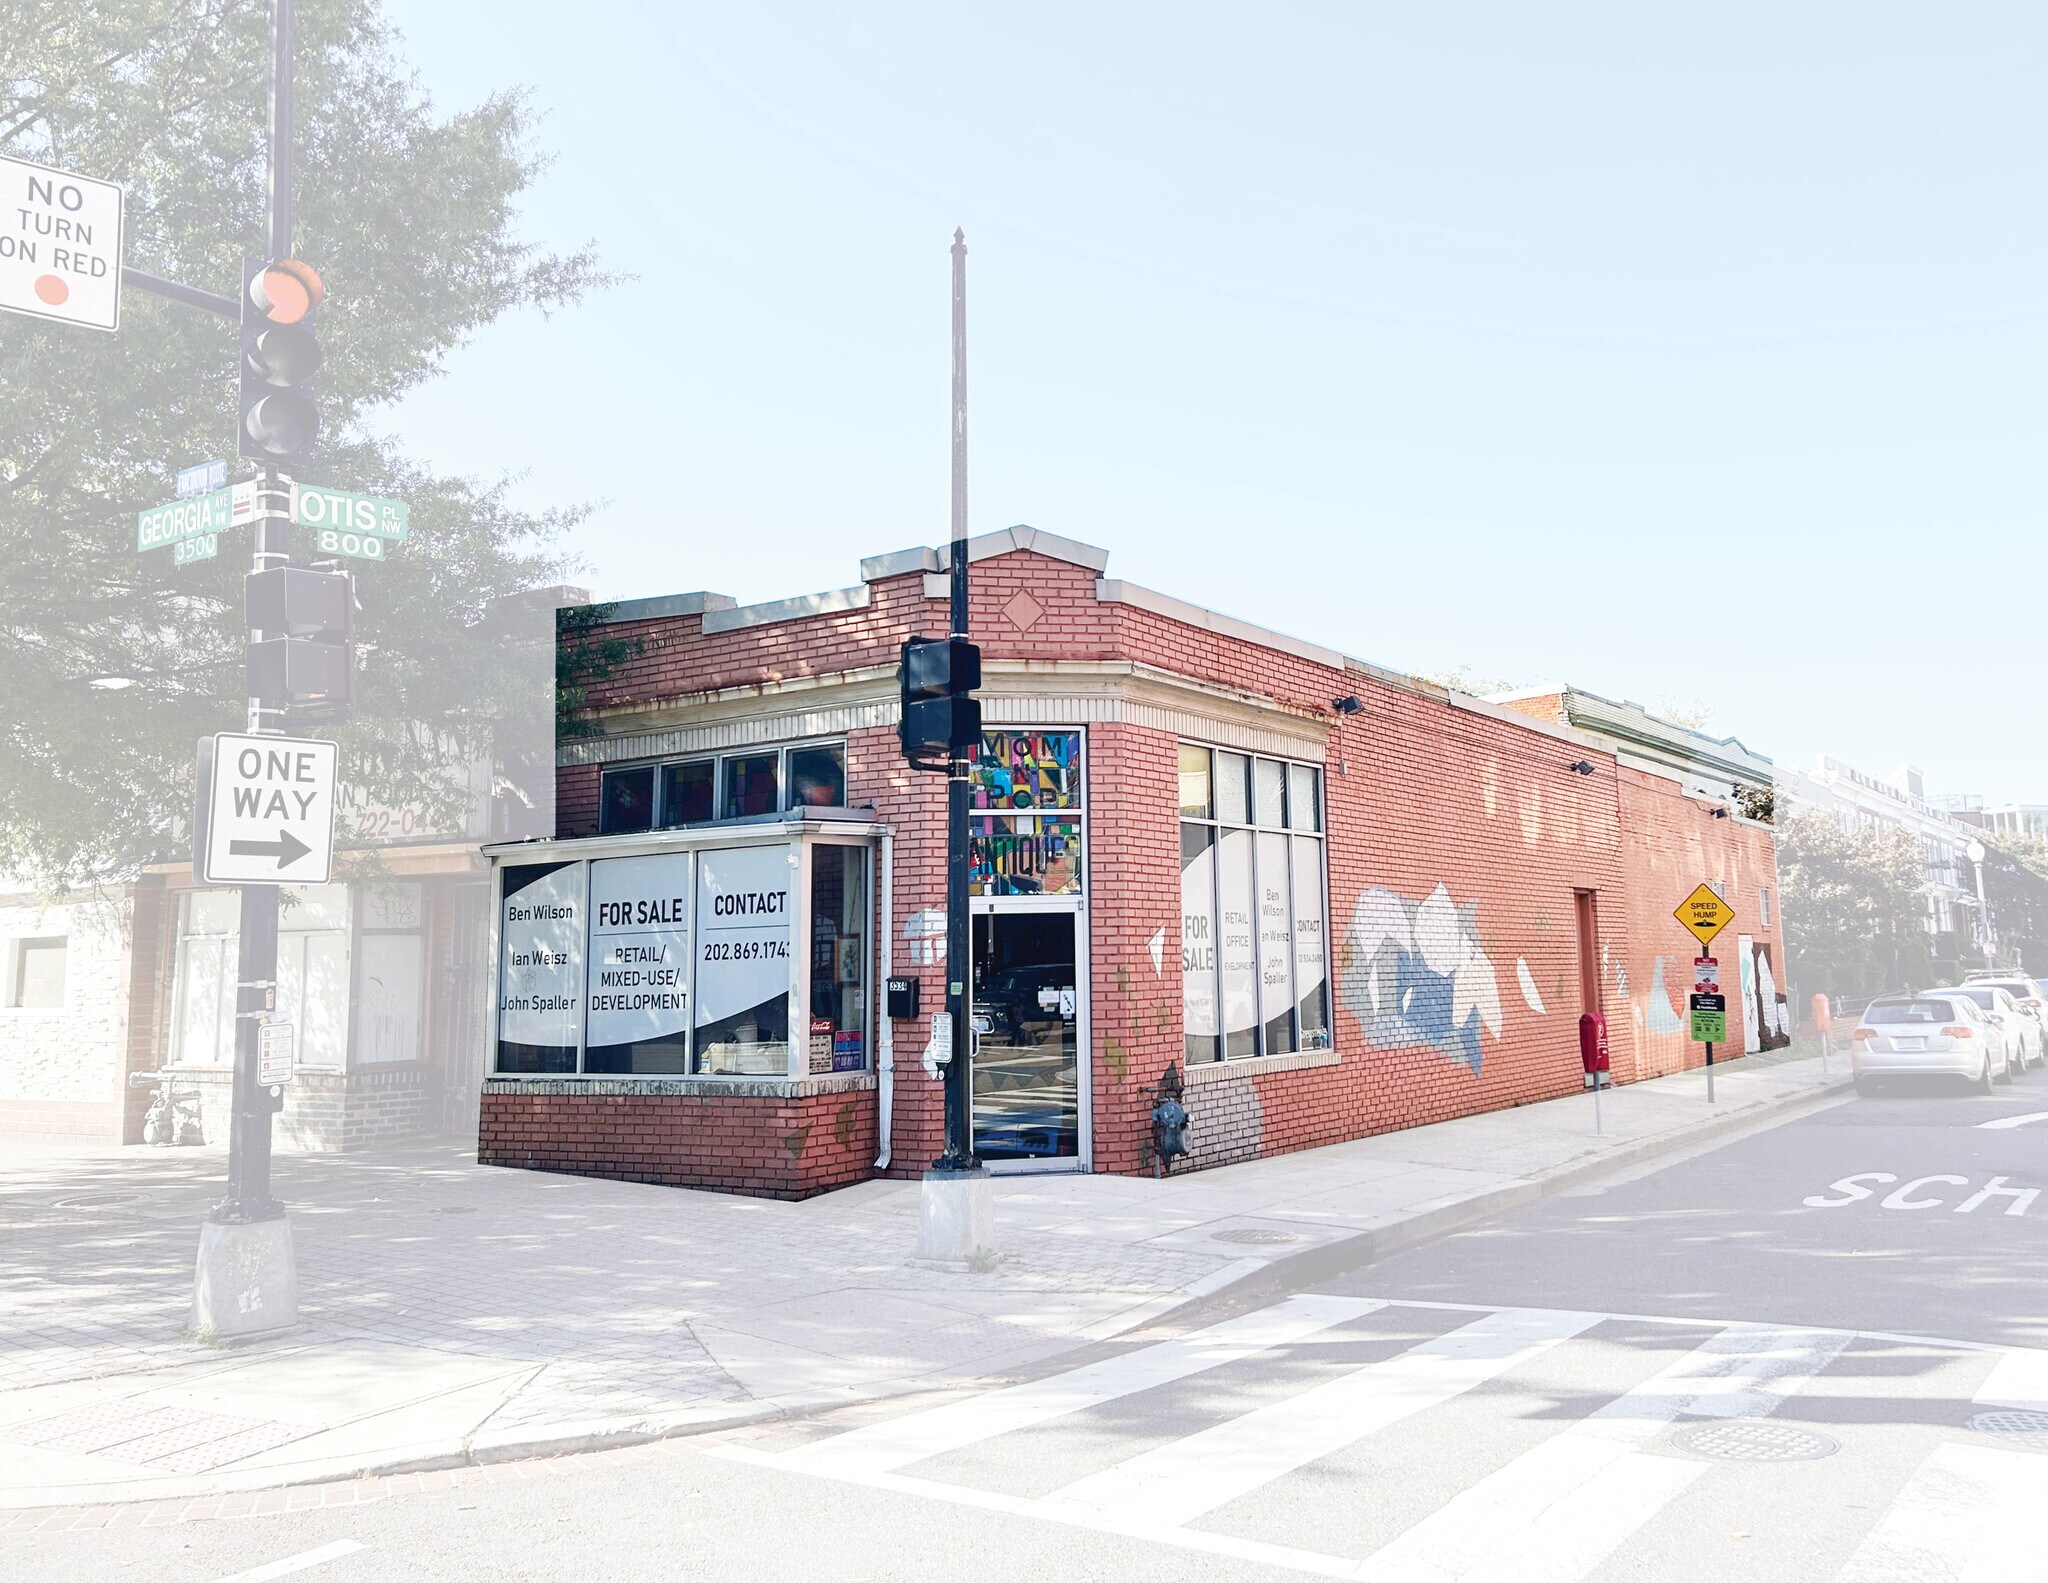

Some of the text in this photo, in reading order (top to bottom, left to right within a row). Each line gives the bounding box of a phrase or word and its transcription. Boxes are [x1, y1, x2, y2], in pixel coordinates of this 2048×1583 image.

[28, 176, 83, 212] NO
[17, 208, 92, 245] TURN
[0, 235, 107, 278] ON RED
[140, 493, 229, 546] GEORGIA AVE
[300, 491, 400, 531] OTIS PL
[382, 521, 401, 534] NW
[177, 533, 217, 560] 3500
[320, 530, 381, 558] 800
[979, 732, 1063, 758] MOM
[238, 748, 316, 783] ONE
[233, 786, 318, 821] WAY
[986, 785, 1057, 809] POP
[714, 891, 787, 917] CONTACT
[1266, 888, 1280, 901] Ben
[1690, 902, 1718, 911] SPEED
[509, 904, 574, 921] Ben Wilson
[599, 899, 683, 927] FOR SALE
[1225, 911, 1249, 925] RETAIL
[1262, 904, 1285, 917] Wilson
[1693, 911, 1718, 919] HUMP
[1184, 915, 1209, 939] FOR
[1226, 935, 1249, 948] OFFICE
[511, 950, 568, 966] Ian Weisz
[615, 944, 667, 965] RETAIL/
[1182, 947, 1214, 972] SALE
[1267, 956, 1284, 969] John
[600, 967, 681, 987] MIXED-USE/
[1263, 972, 1287, 986] Spaller
[501, 995, 576, 1014] John Spaller
[592, 993, 687, 1012] DEVELOPMENT
[1802, 1172, 2042, 1216] SCH
